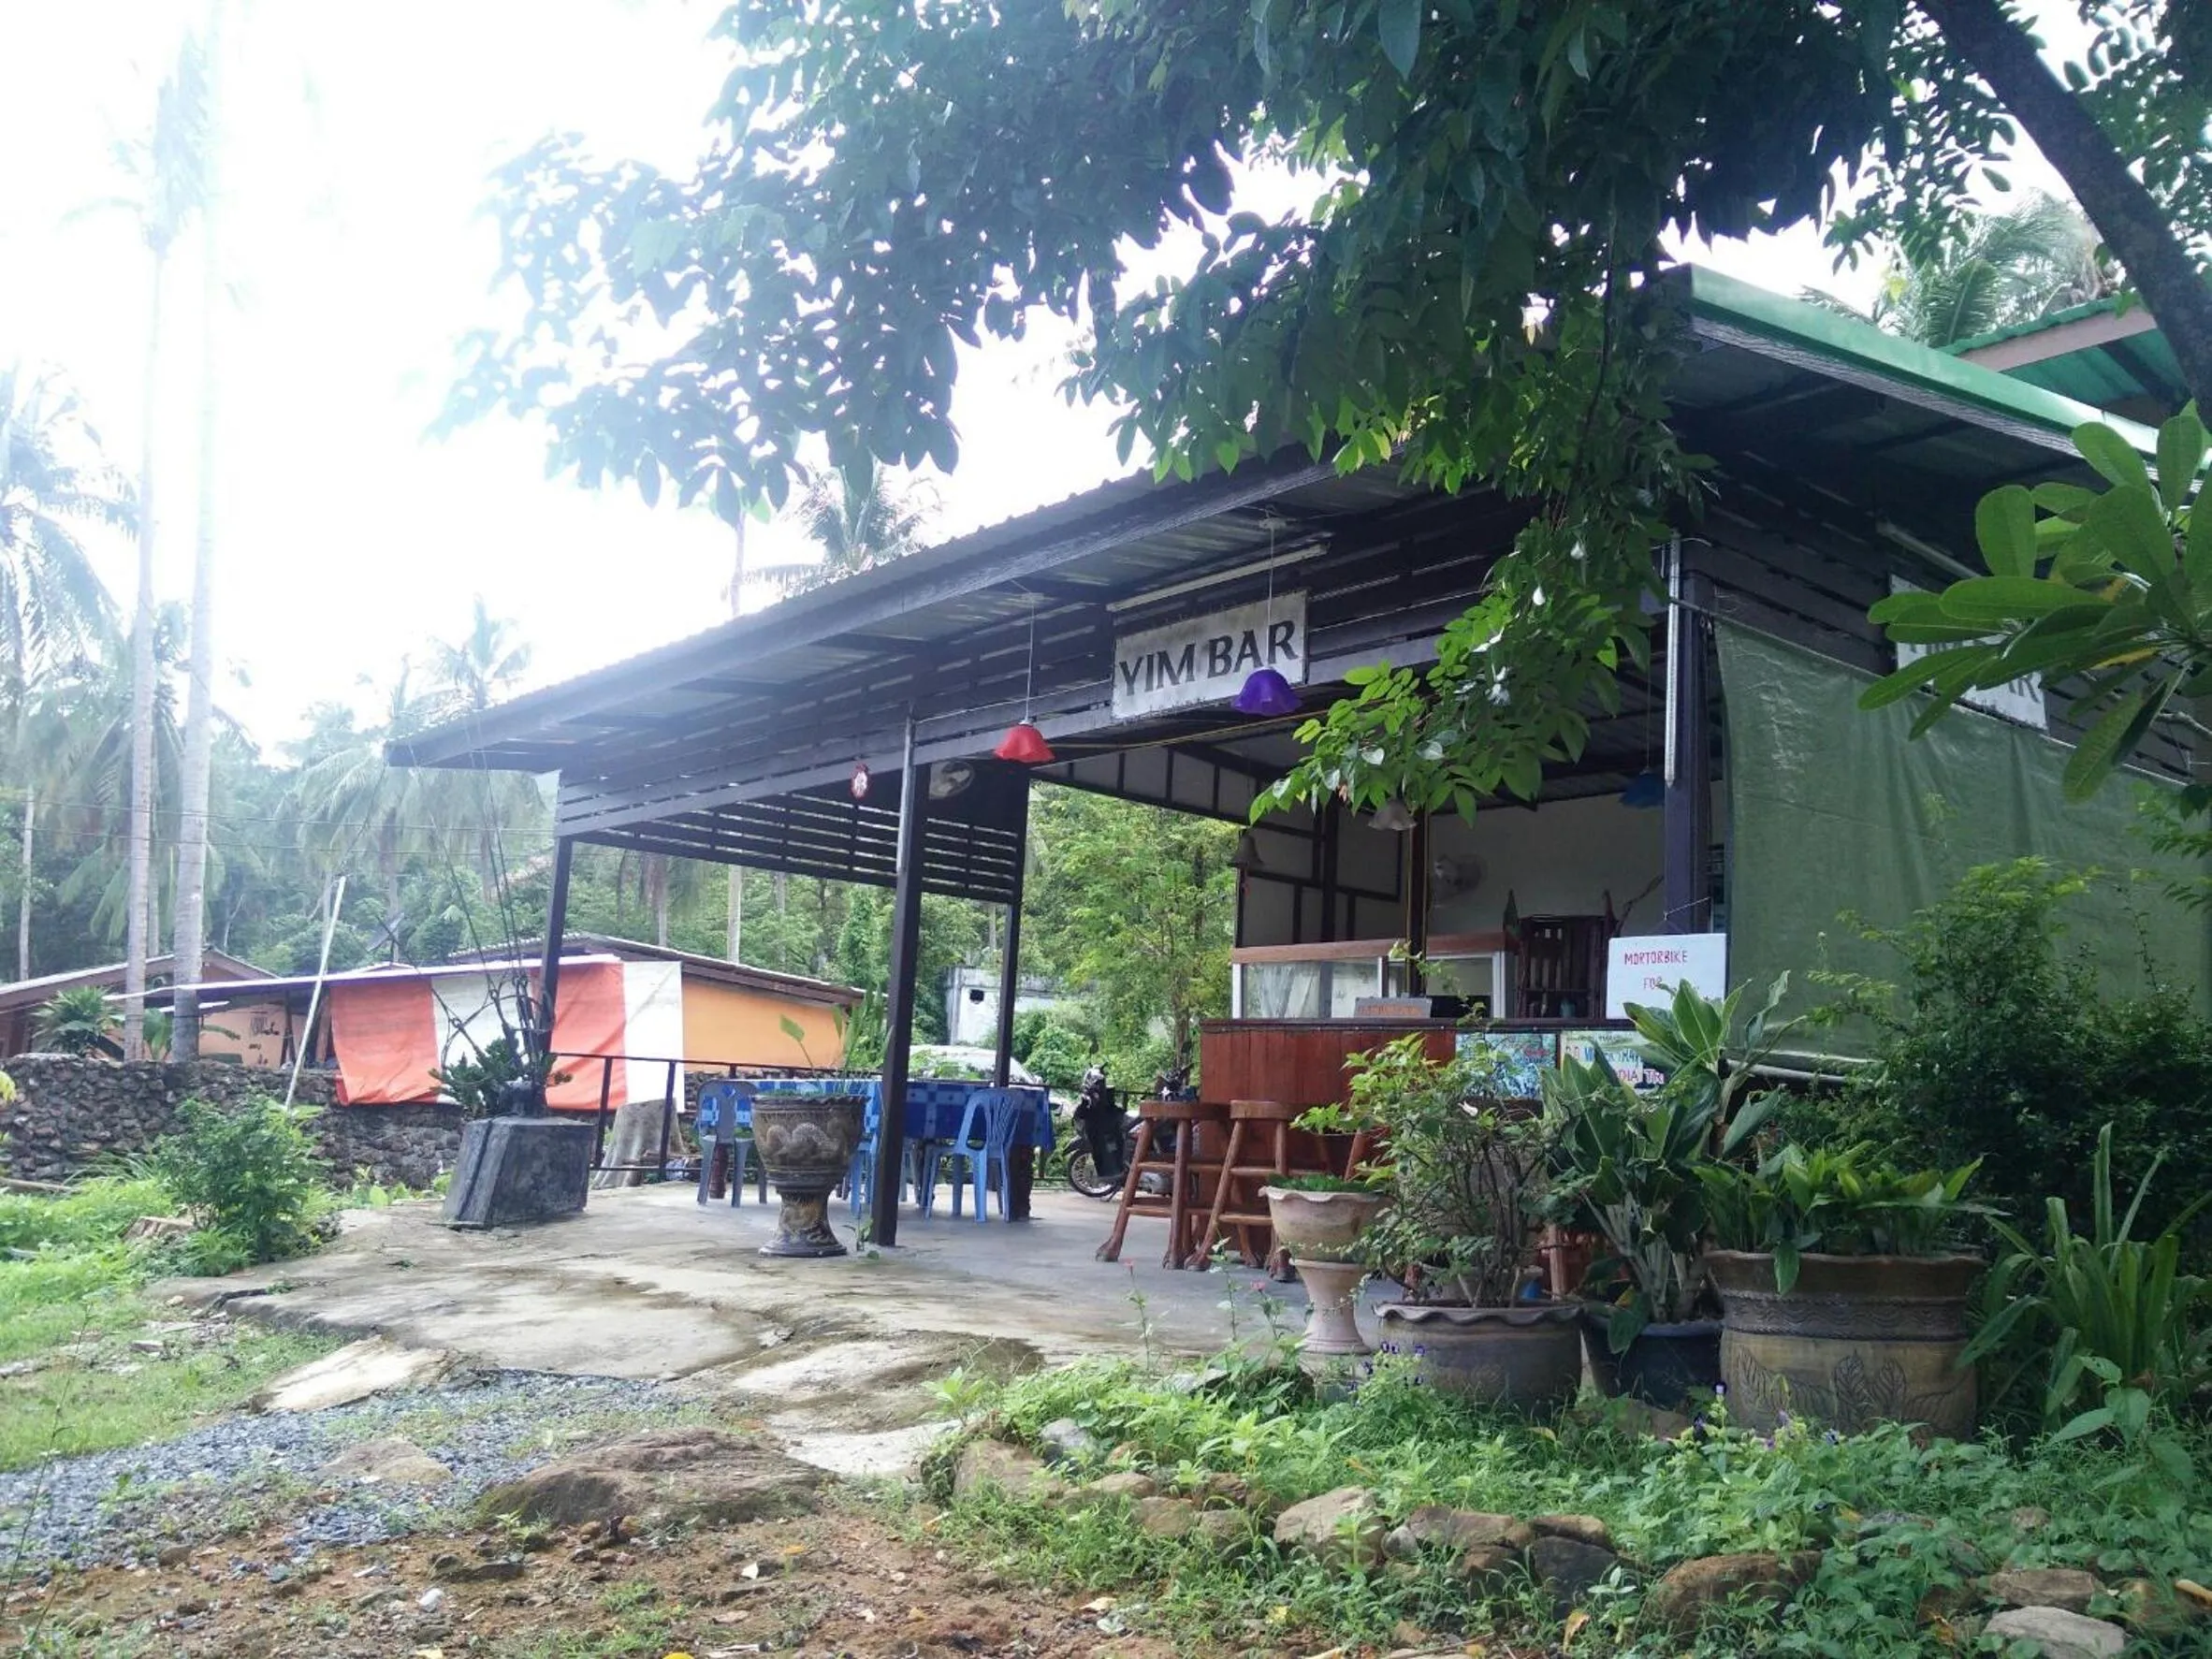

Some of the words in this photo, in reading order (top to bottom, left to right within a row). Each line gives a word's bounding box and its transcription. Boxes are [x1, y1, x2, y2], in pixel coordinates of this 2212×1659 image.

[1119, 643, 1197, 696] YIM
[1207, 619, 1299, 678] BAR
[1623, 950, 1688, 966] MORTORBIKE
